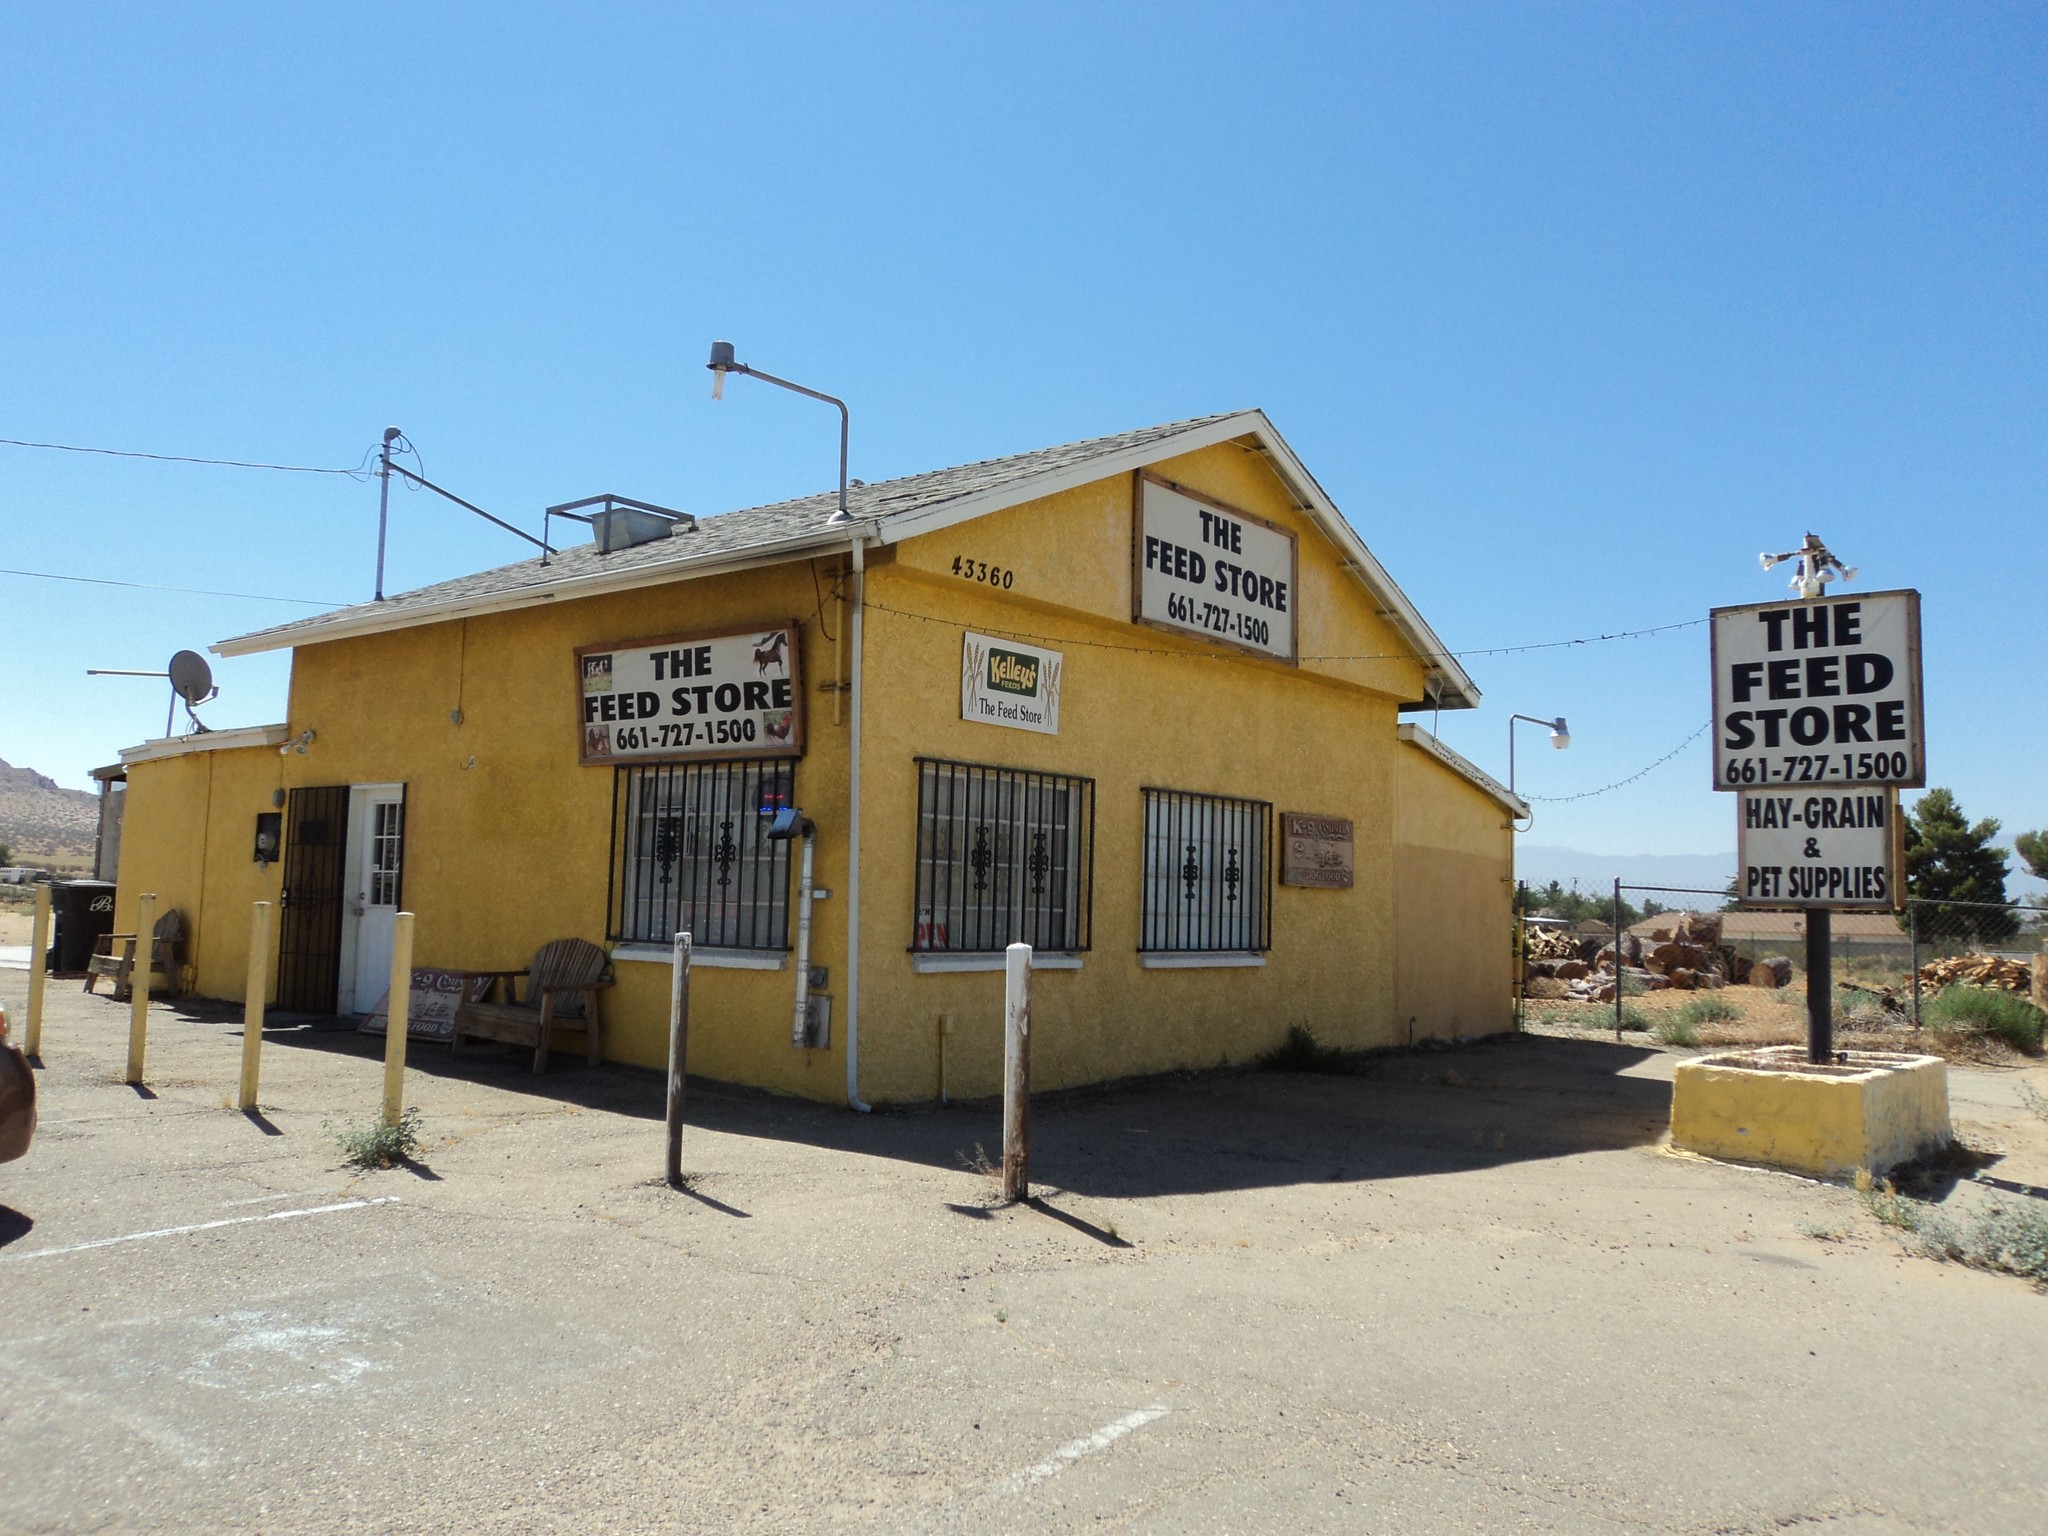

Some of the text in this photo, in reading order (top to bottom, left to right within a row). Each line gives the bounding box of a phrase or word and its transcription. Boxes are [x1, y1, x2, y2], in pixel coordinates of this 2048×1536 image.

[1199, 509, 1242, 556] THE
[951, 555, 1013, 589] 43360
[1146, 535, 1287, 613] FEED STORE
[1167, 592, 1269, 646] 661-727-1500
[1759, 602, 1862, 652] THE
[650, 645, 712, 681] THE
[1731, 653, 1894, 703] FEED
[585, 678, 792, 723] FEED STORE
[1001, 680, 1021, 691] FEEDS
[979, 697, 1042, 724] The Feed Store
[1725, 700, 1906, 750] STORE
[616, 718, 756, 750] 661-727-1500
[1726, 751, 1907, 783] 661-727-1500
[1292, 819, 1315, 835] K-9
[1746, 796, 1885, 830] HAY-GRAIN
[1803, 837, 1822, 858] &
[1747, 866, 1886, 900] PET SUPPLIES
[411, 1022, 438, 1033] FOOD
